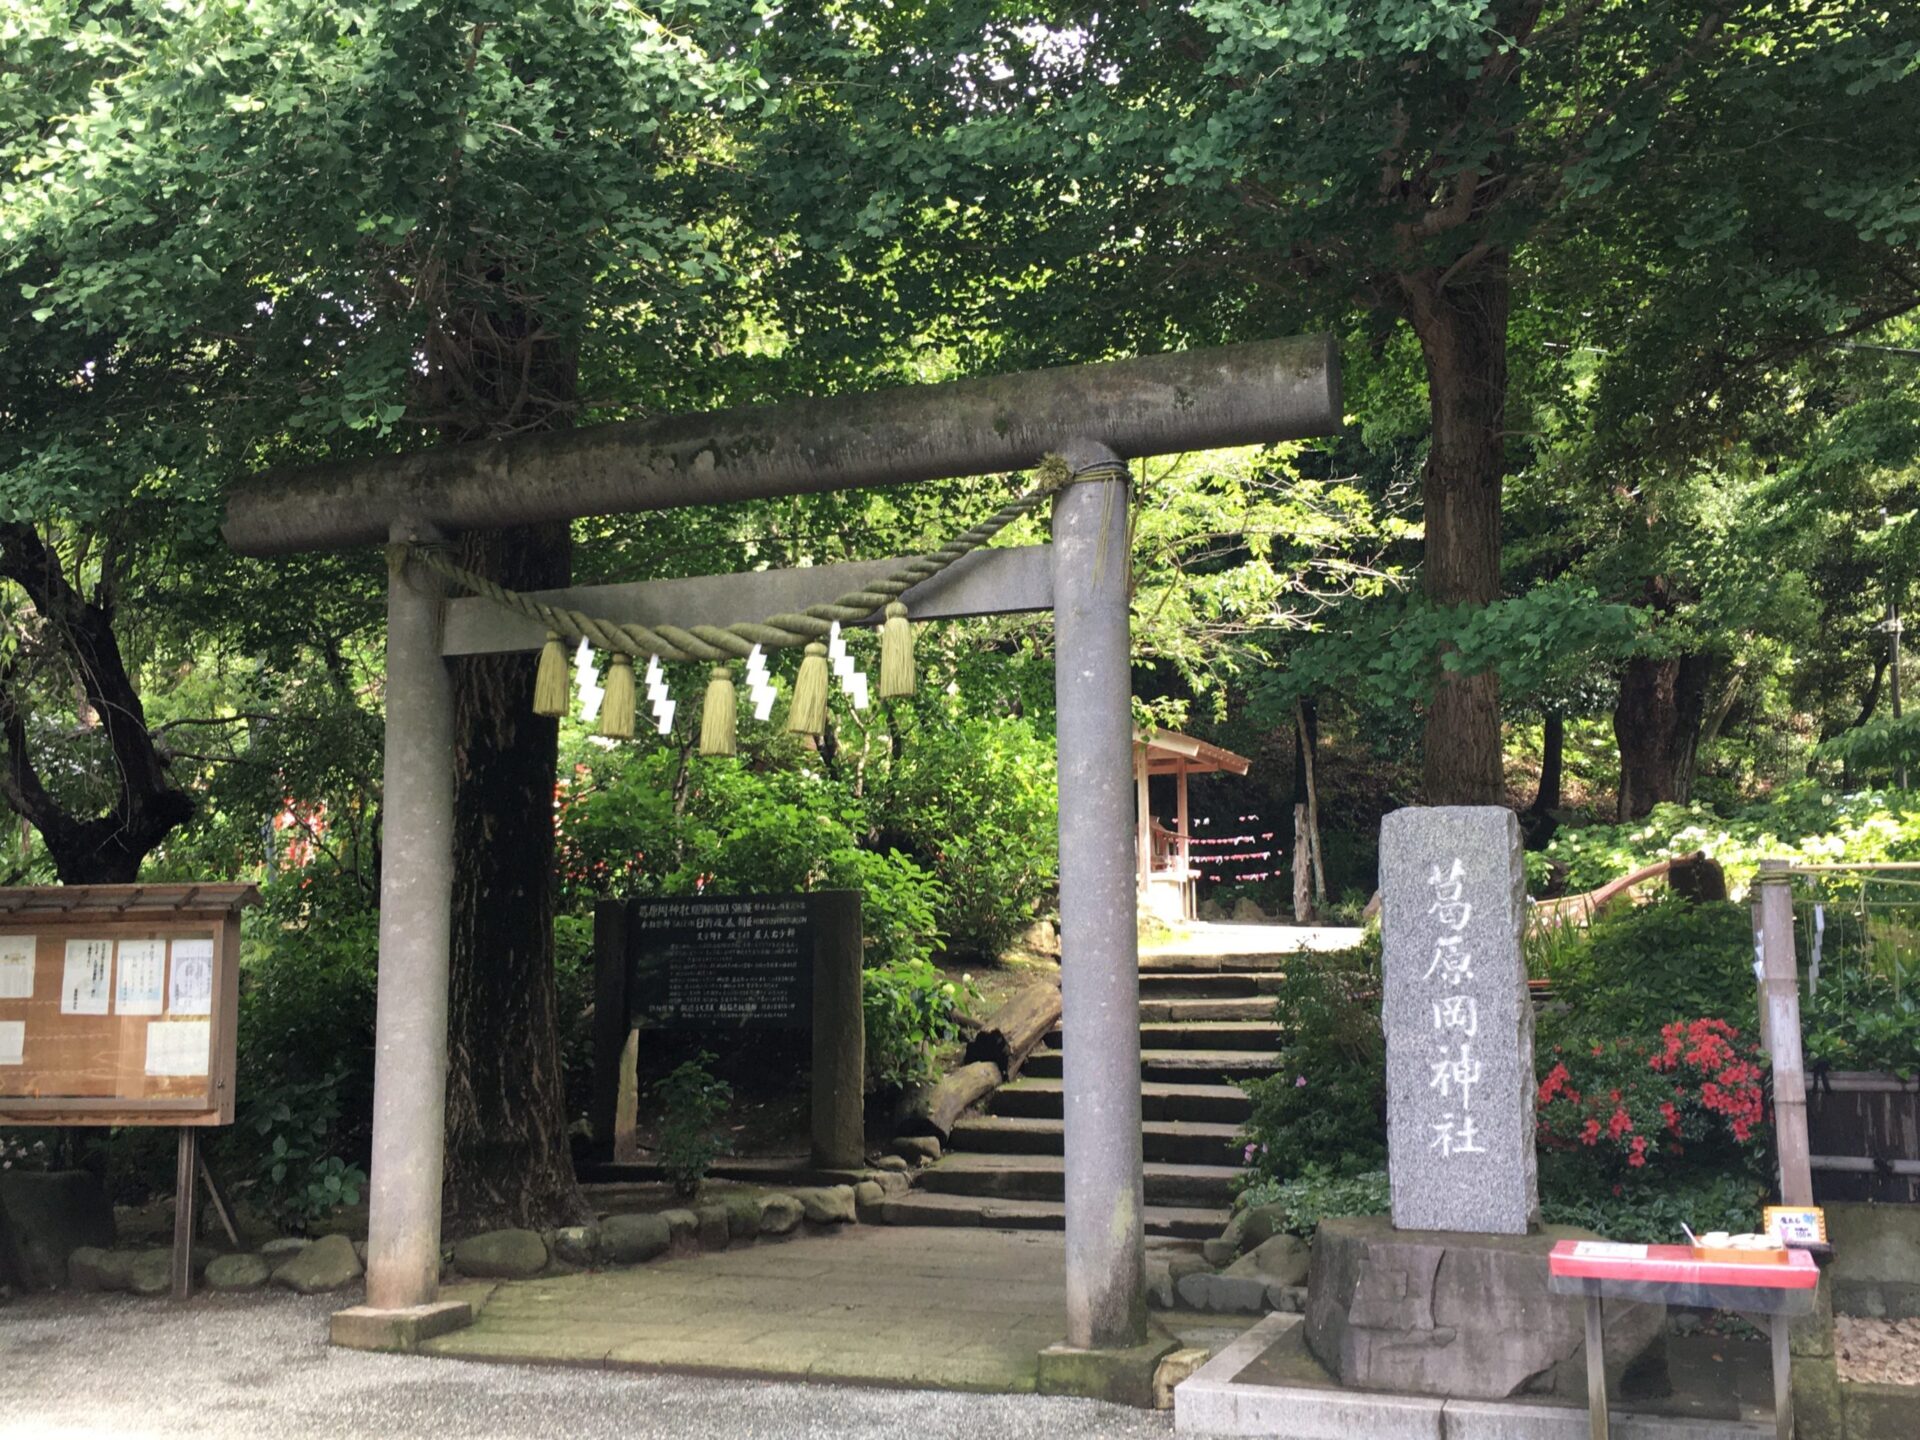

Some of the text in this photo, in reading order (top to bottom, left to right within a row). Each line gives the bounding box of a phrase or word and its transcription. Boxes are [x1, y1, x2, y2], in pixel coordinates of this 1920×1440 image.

[1423, 858, 1485, 1157] 葛原岡神社
